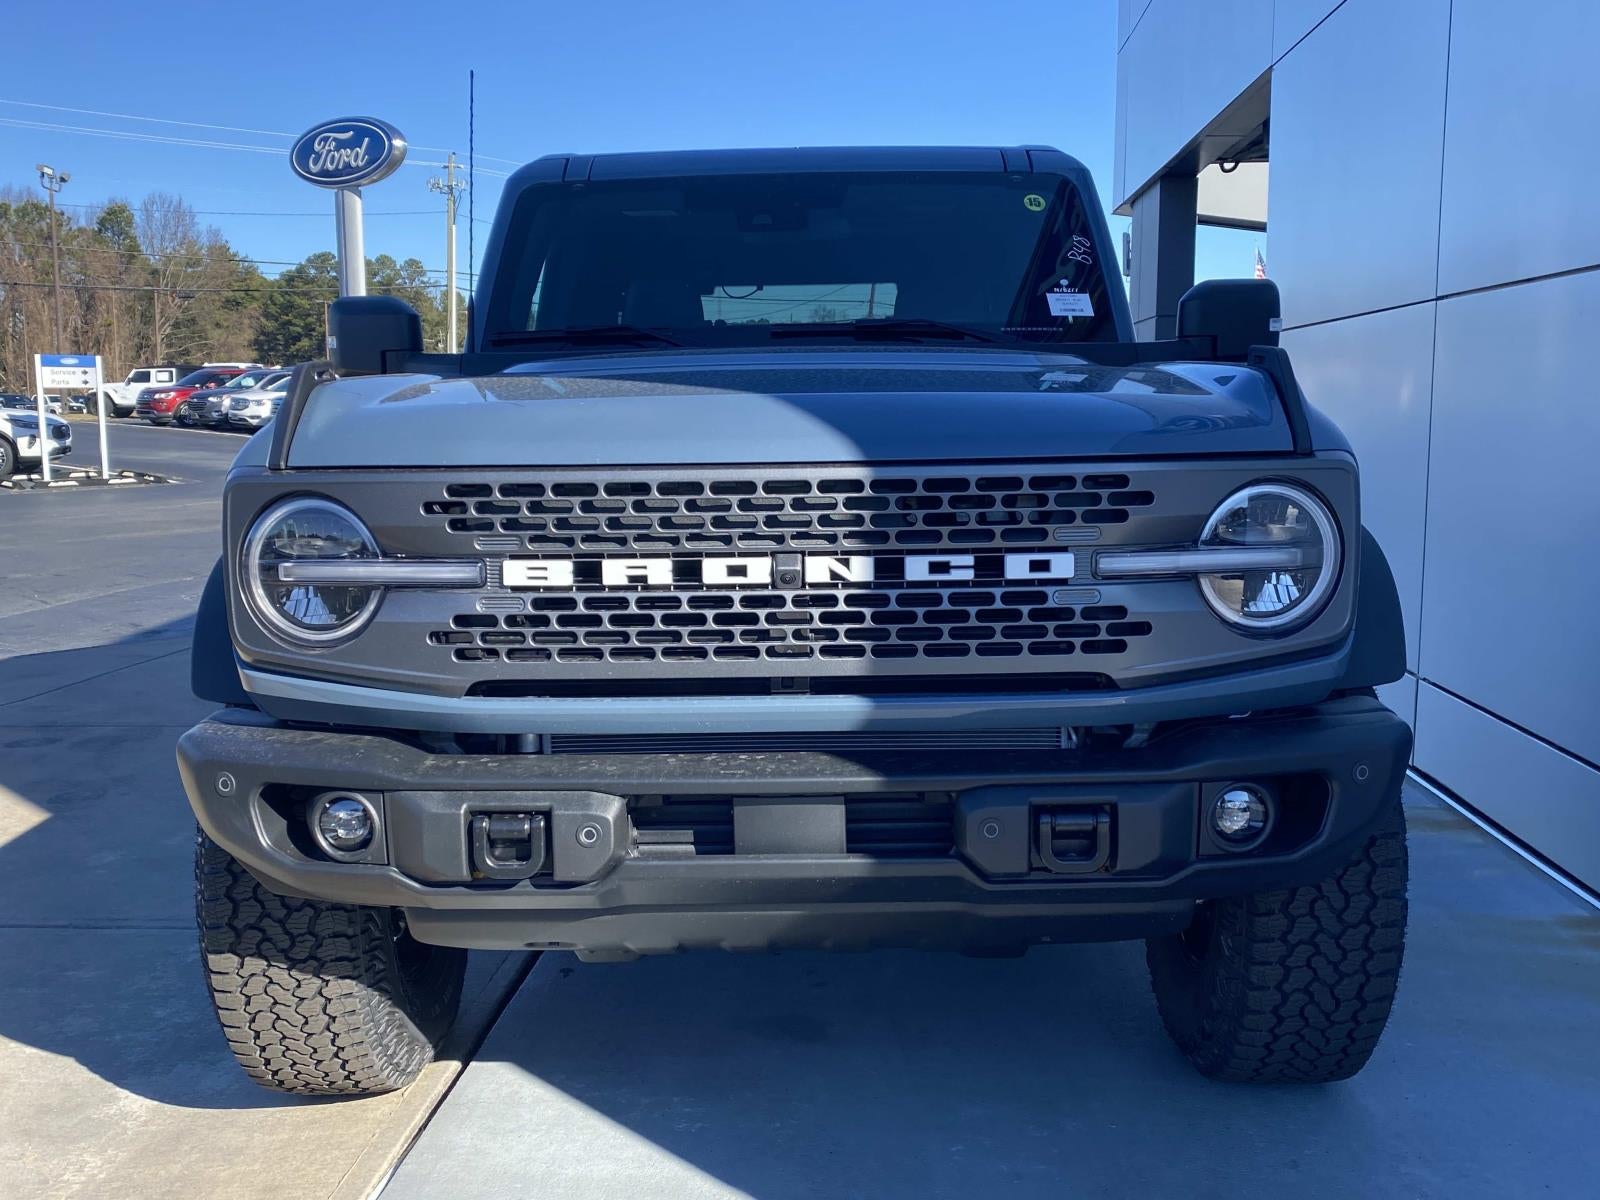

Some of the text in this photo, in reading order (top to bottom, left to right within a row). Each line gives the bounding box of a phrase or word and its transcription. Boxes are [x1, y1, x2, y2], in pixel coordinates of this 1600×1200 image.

[309, 130, 369, 173] Ford
[1027, 197, 1042, 207] 15
[502, 553, 1075, 587] BRONCO
